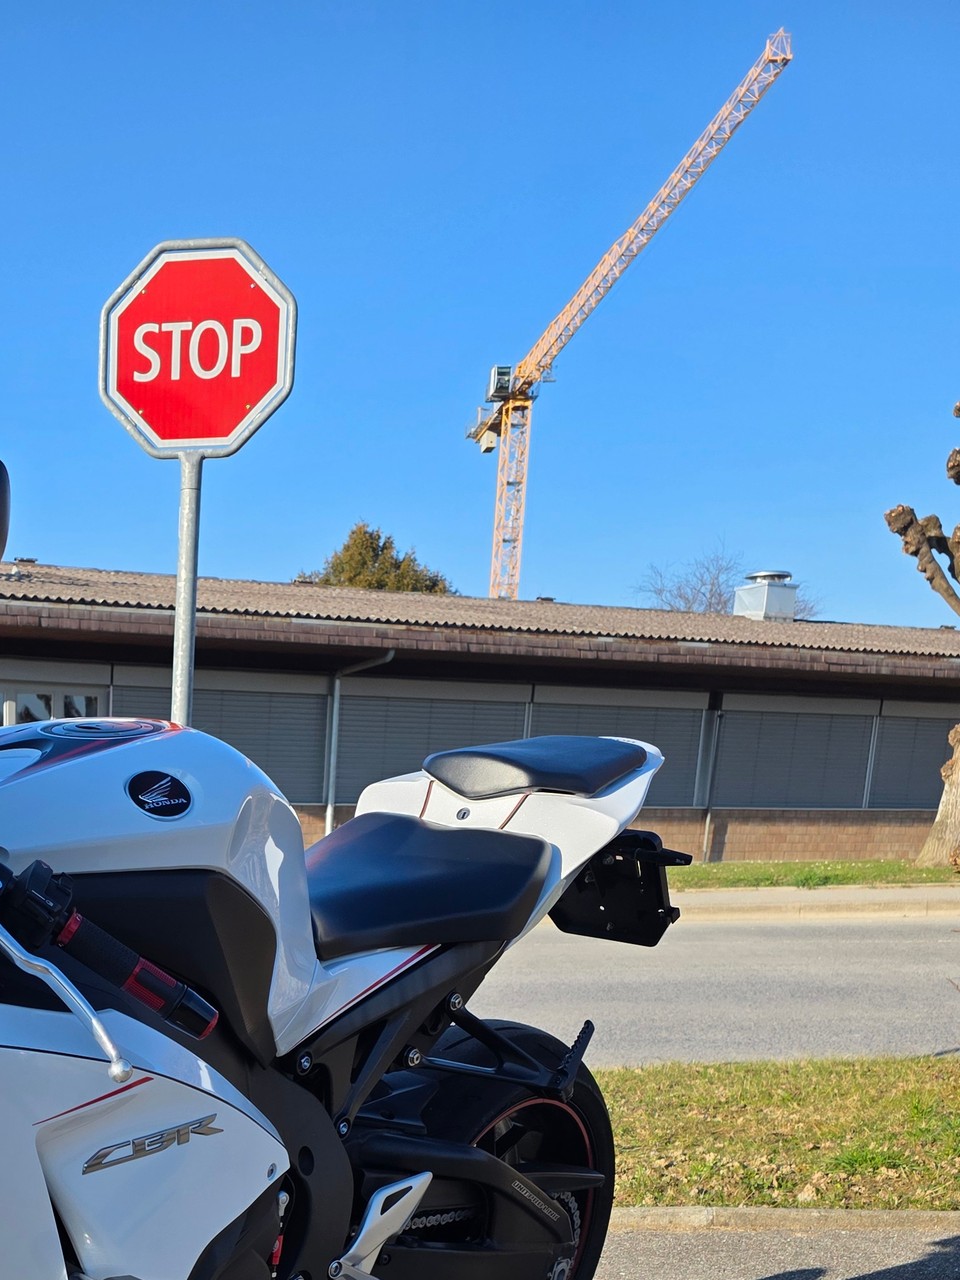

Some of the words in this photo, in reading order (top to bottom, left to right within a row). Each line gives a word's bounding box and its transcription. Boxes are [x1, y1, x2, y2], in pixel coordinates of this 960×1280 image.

[133, 318, 262, 383] STOP
[144, 797, 188, 809] HONDA
[82, 1113, 224, 1175] CBR
